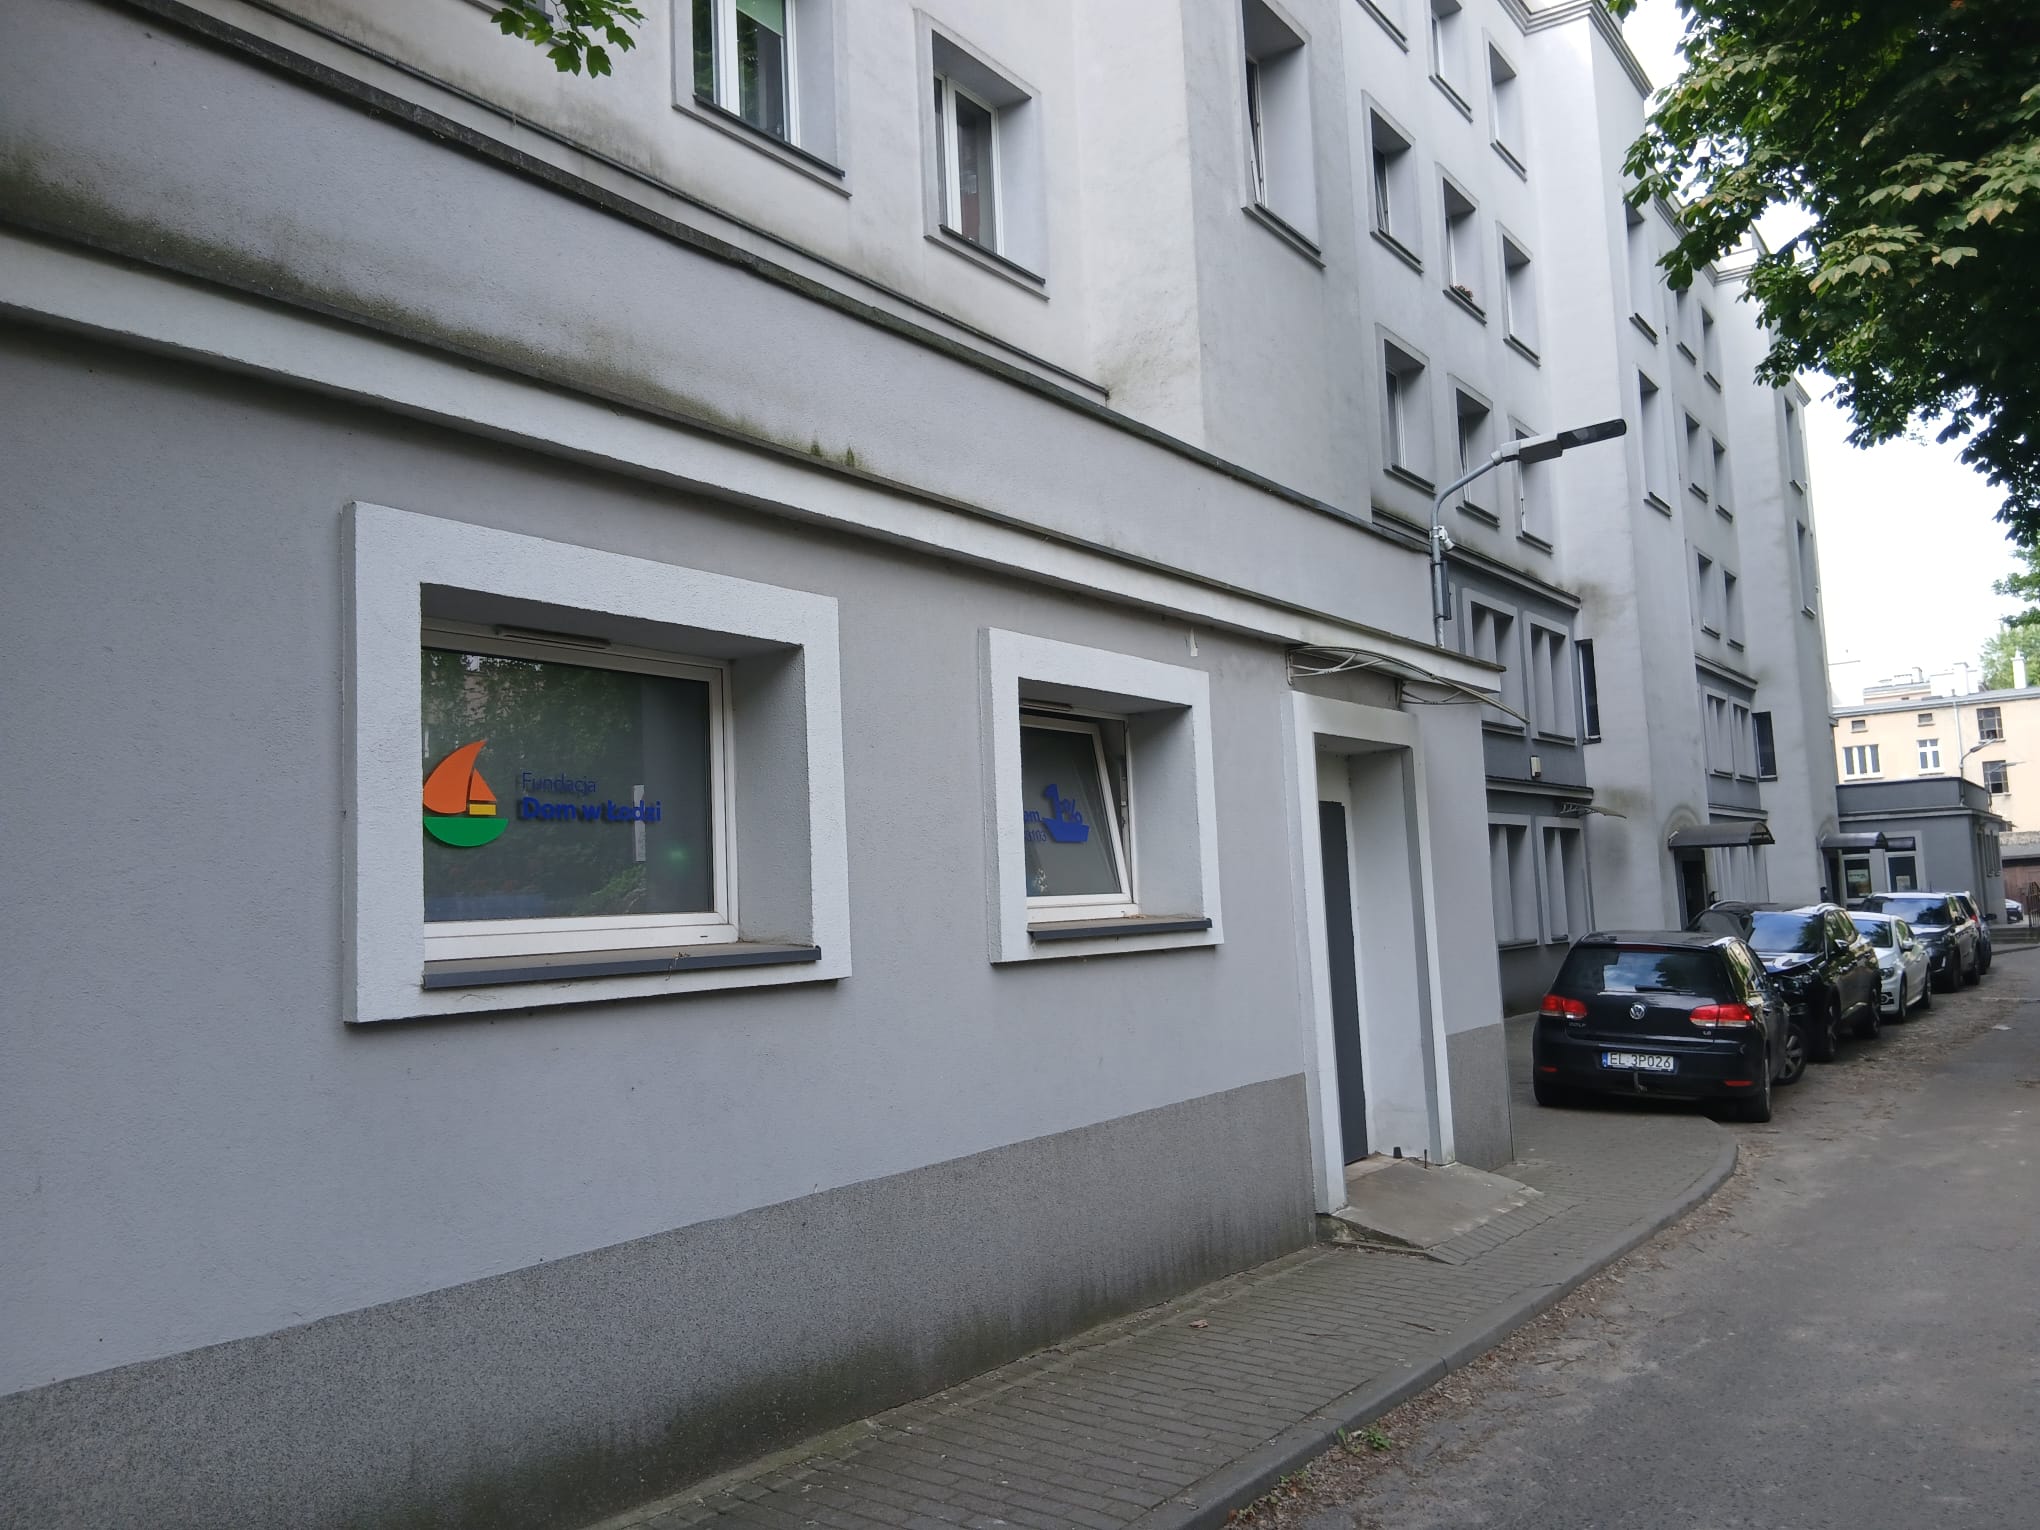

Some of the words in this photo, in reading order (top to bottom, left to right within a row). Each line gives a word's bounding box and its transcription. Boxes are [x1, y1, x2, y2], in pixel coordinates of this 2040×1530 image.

[522, 772, 597, 795] Fundacja
[521, 797, 576, 821] Dom
[582, 803, 600, 821] w
[606, 799, 662, 822] Łodzi
[1610, 1052, 1625, 1066] EL
[1631, 1054, 1671, 1068] 3P026
